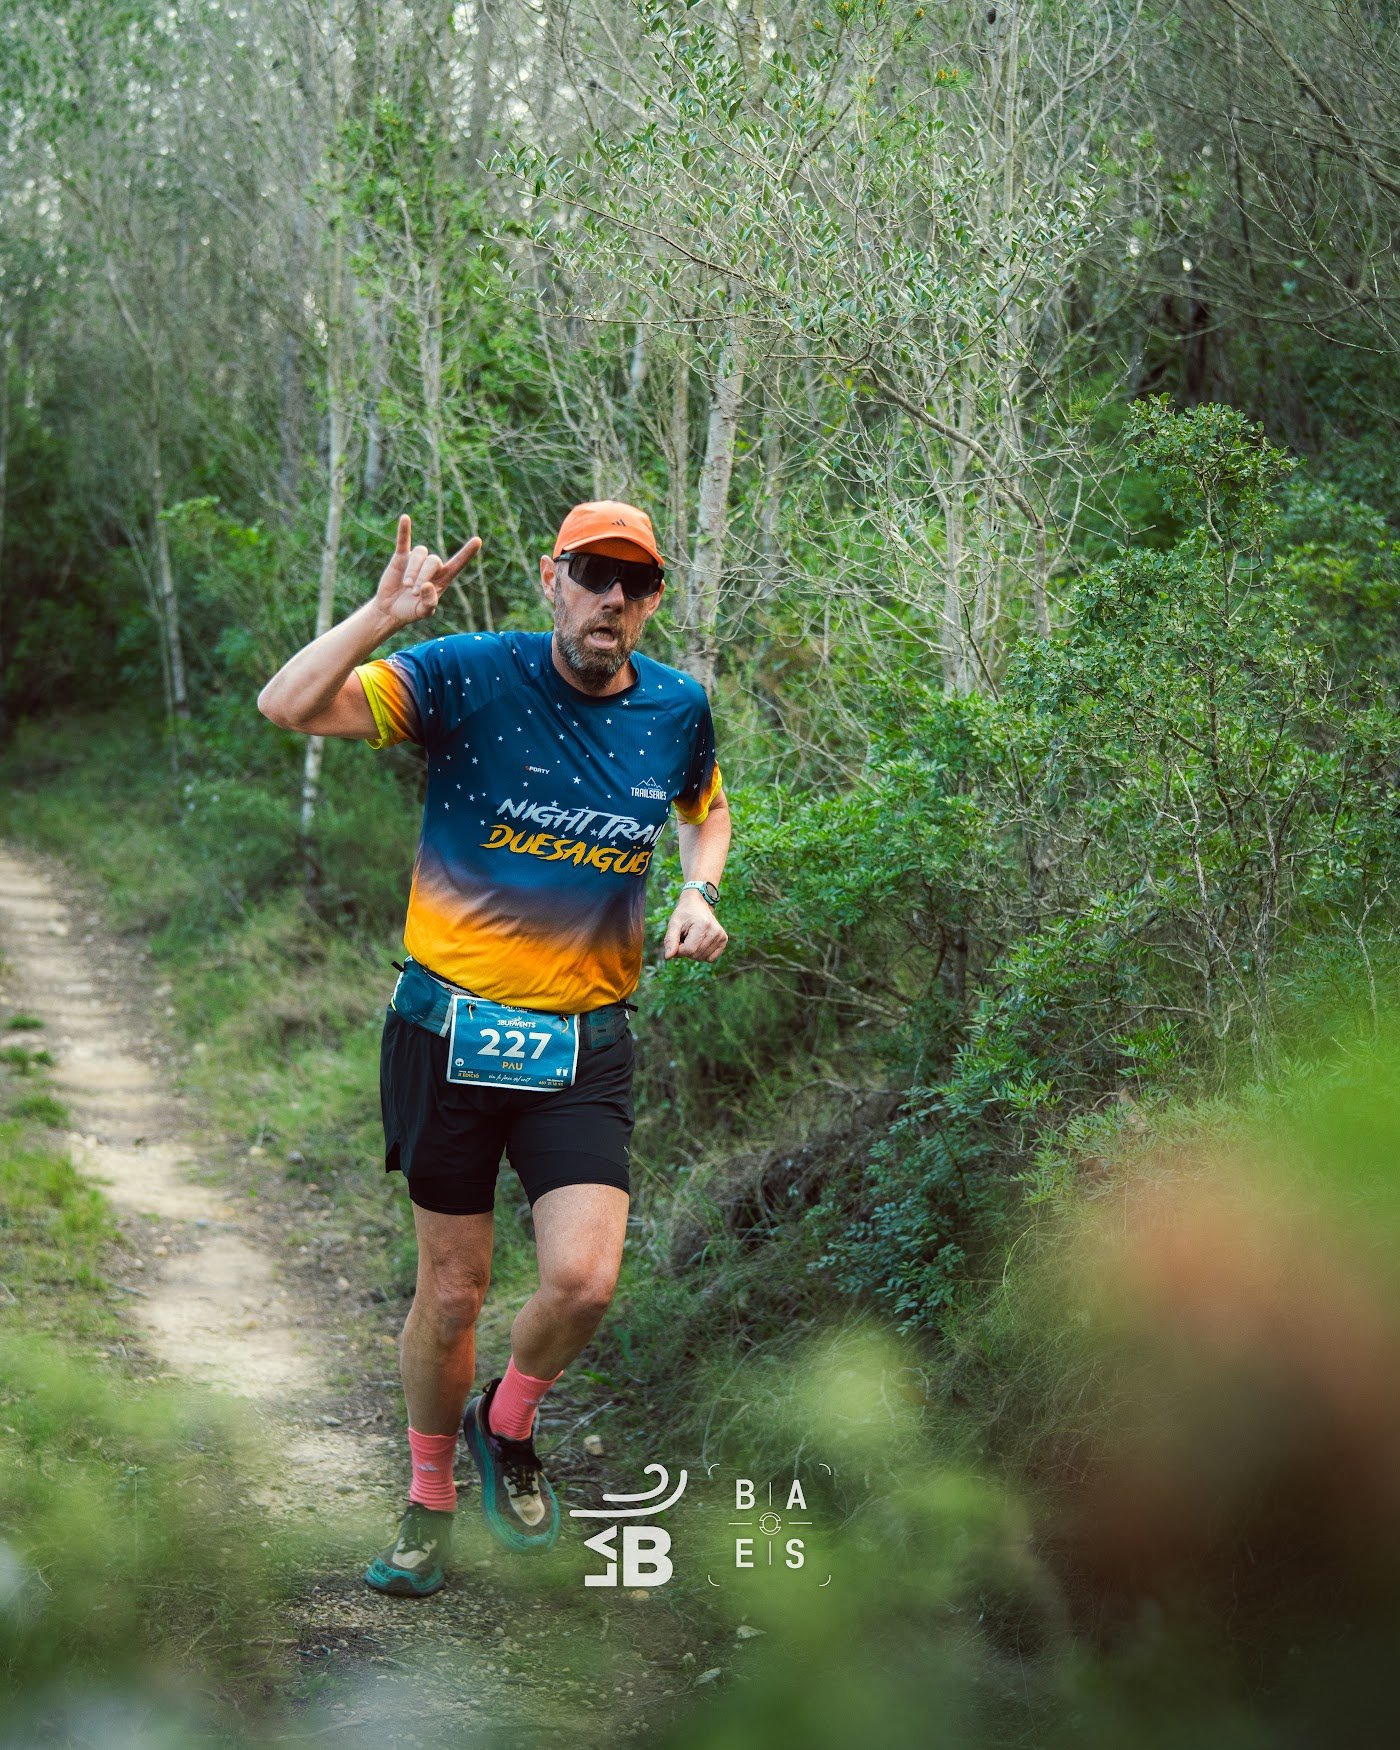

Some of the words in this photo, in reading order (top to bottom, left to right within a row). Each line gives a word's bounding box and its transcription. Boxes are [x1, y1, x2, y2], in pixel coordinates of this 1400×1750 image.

[630, 786, 667, 800] TRAILSERIES
[496, 798, 600, 836] NIGHT
[477, 1028, 553, 1060] 227
[502, 1062, 523, 1071] PAU
